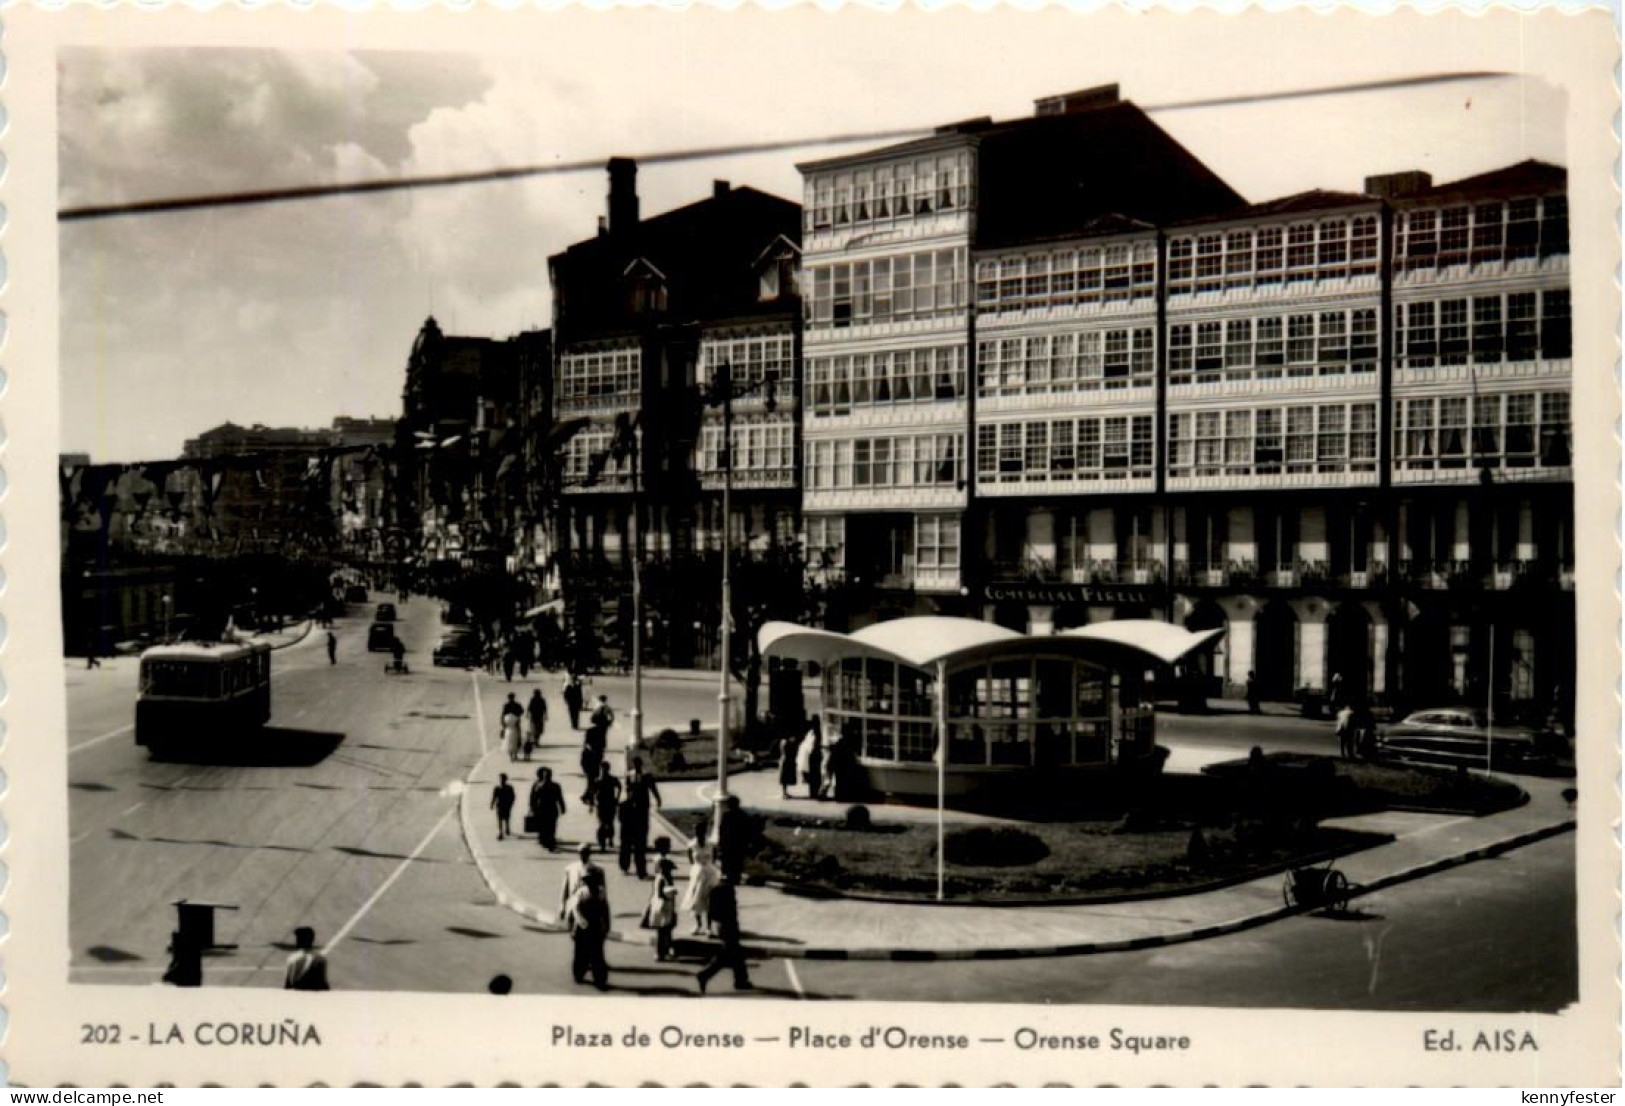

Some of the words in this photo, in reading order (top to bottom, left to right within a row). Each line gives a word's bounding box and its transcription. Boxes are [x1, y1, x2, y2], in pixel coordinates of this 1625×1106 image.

[1081, 586, 1153, 604] PIRELL
[82, 1024, 120, 1044] 202
[149, 1023, 185, 1045] LA
[194, 1018, 321, 1046] CORUÑA
[552, 1025, 612, 1047] Plaza
[622, 1025, 650, 1047] de
[660, 1025, 744, 1049] Orense
[789, 1026, 851, 1049] Place
[860, 1026, 968, 1049] d'Orense
[1014, 1027, 1099, 1049] Orense
[1110, 1028, 1190, 1054] Square
[1424, 1029, 1461, 1051] Ed.
[1472, 1029, 1538, 1052] AISA
